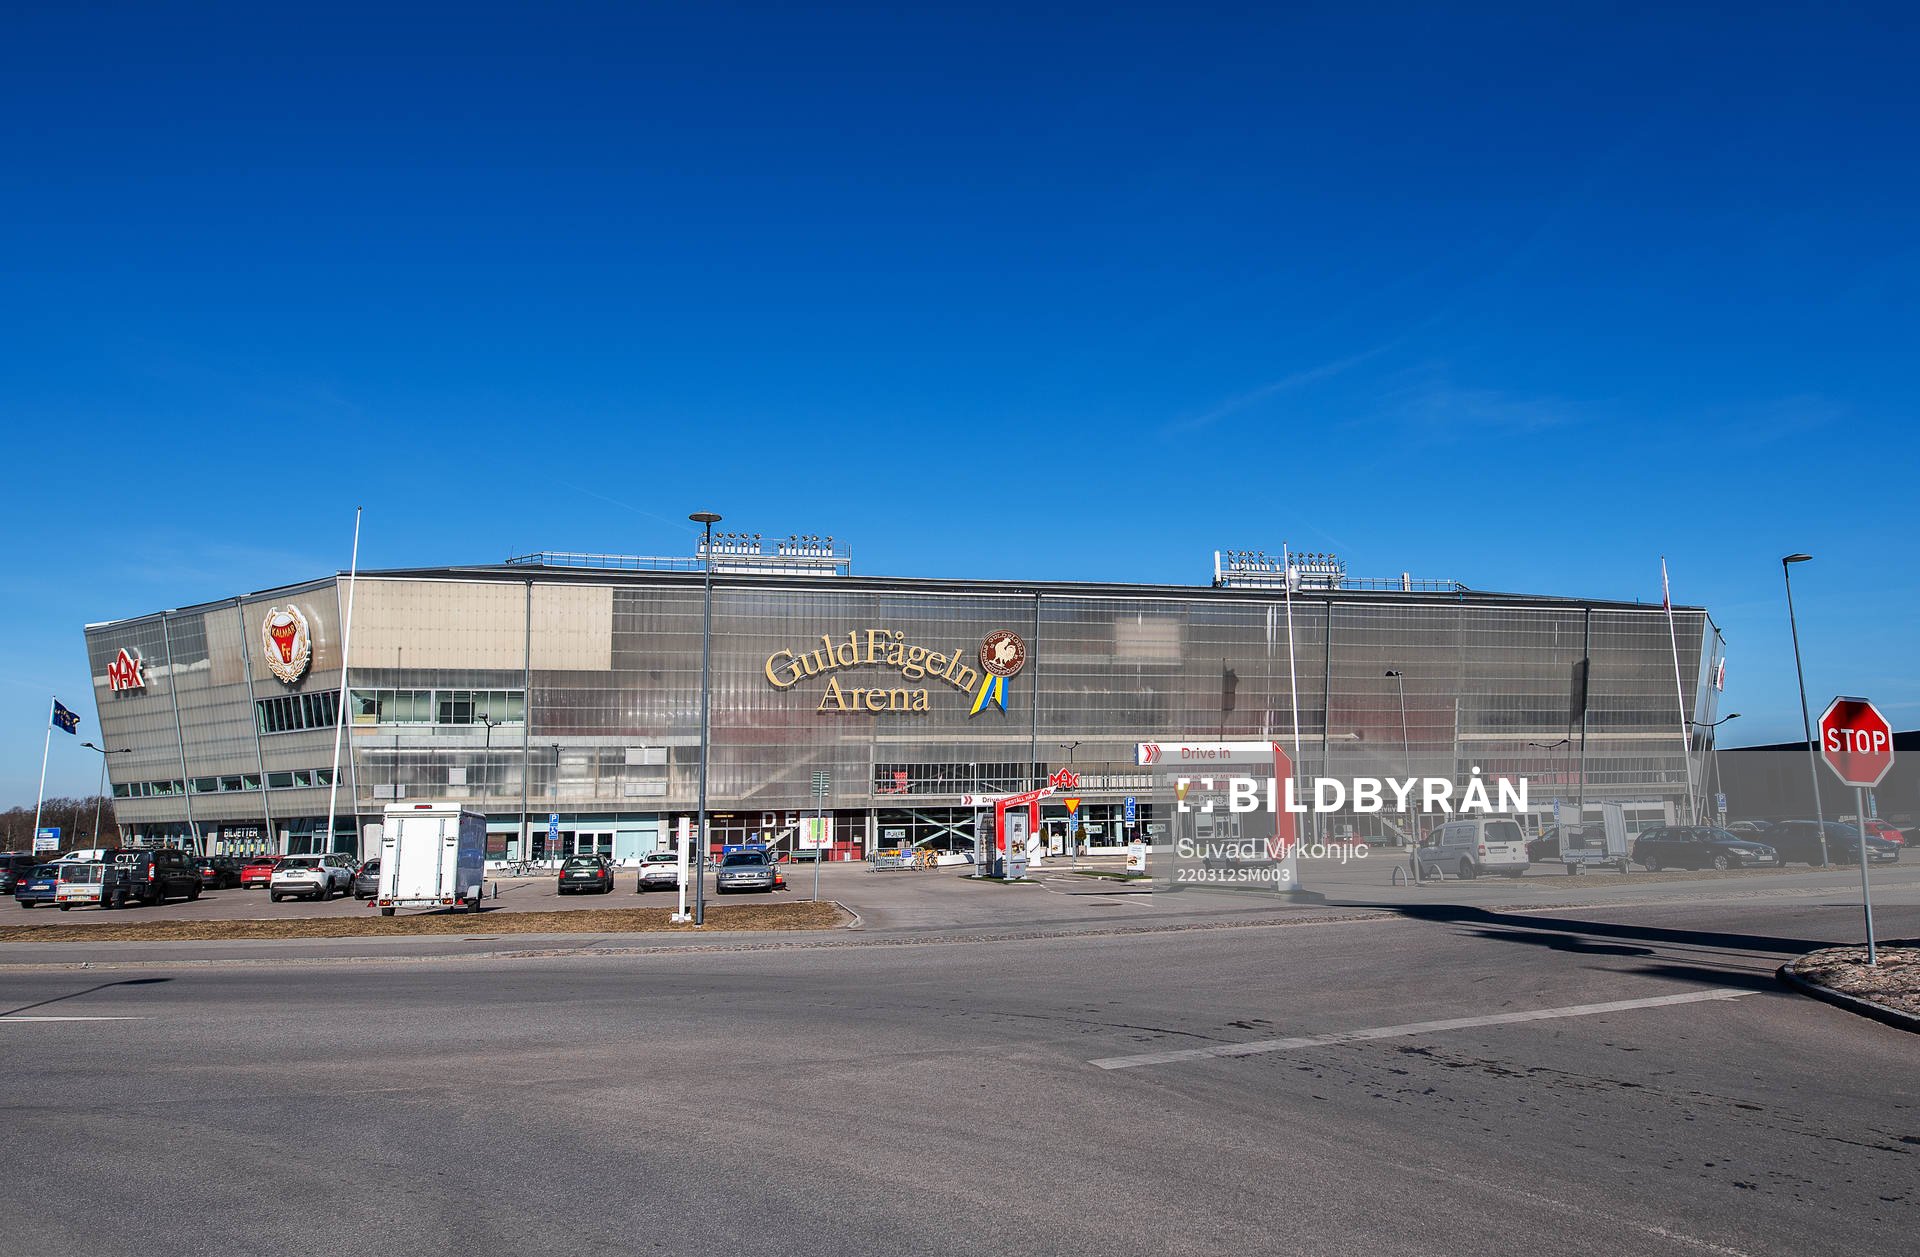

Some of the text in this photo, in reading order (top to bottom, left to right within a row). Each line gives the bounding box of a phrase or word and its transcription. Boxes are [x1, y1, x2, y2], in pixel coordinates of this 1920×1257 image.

[271, 624, 296, 638] KALMAR
[107, 648, 145, 690] MAX
[765, 629, 978, 692] GuldFågeln
[817, 676, 930, 711] Arena
[1827, 728, 1886, 756] STOP
[1181, 747, 1231, 760] Drive in
[1049, 768, 1080, 789] MAX
[224, 827, 258, 838] BILJETTER
[115, 853, 140, 863] CTV
